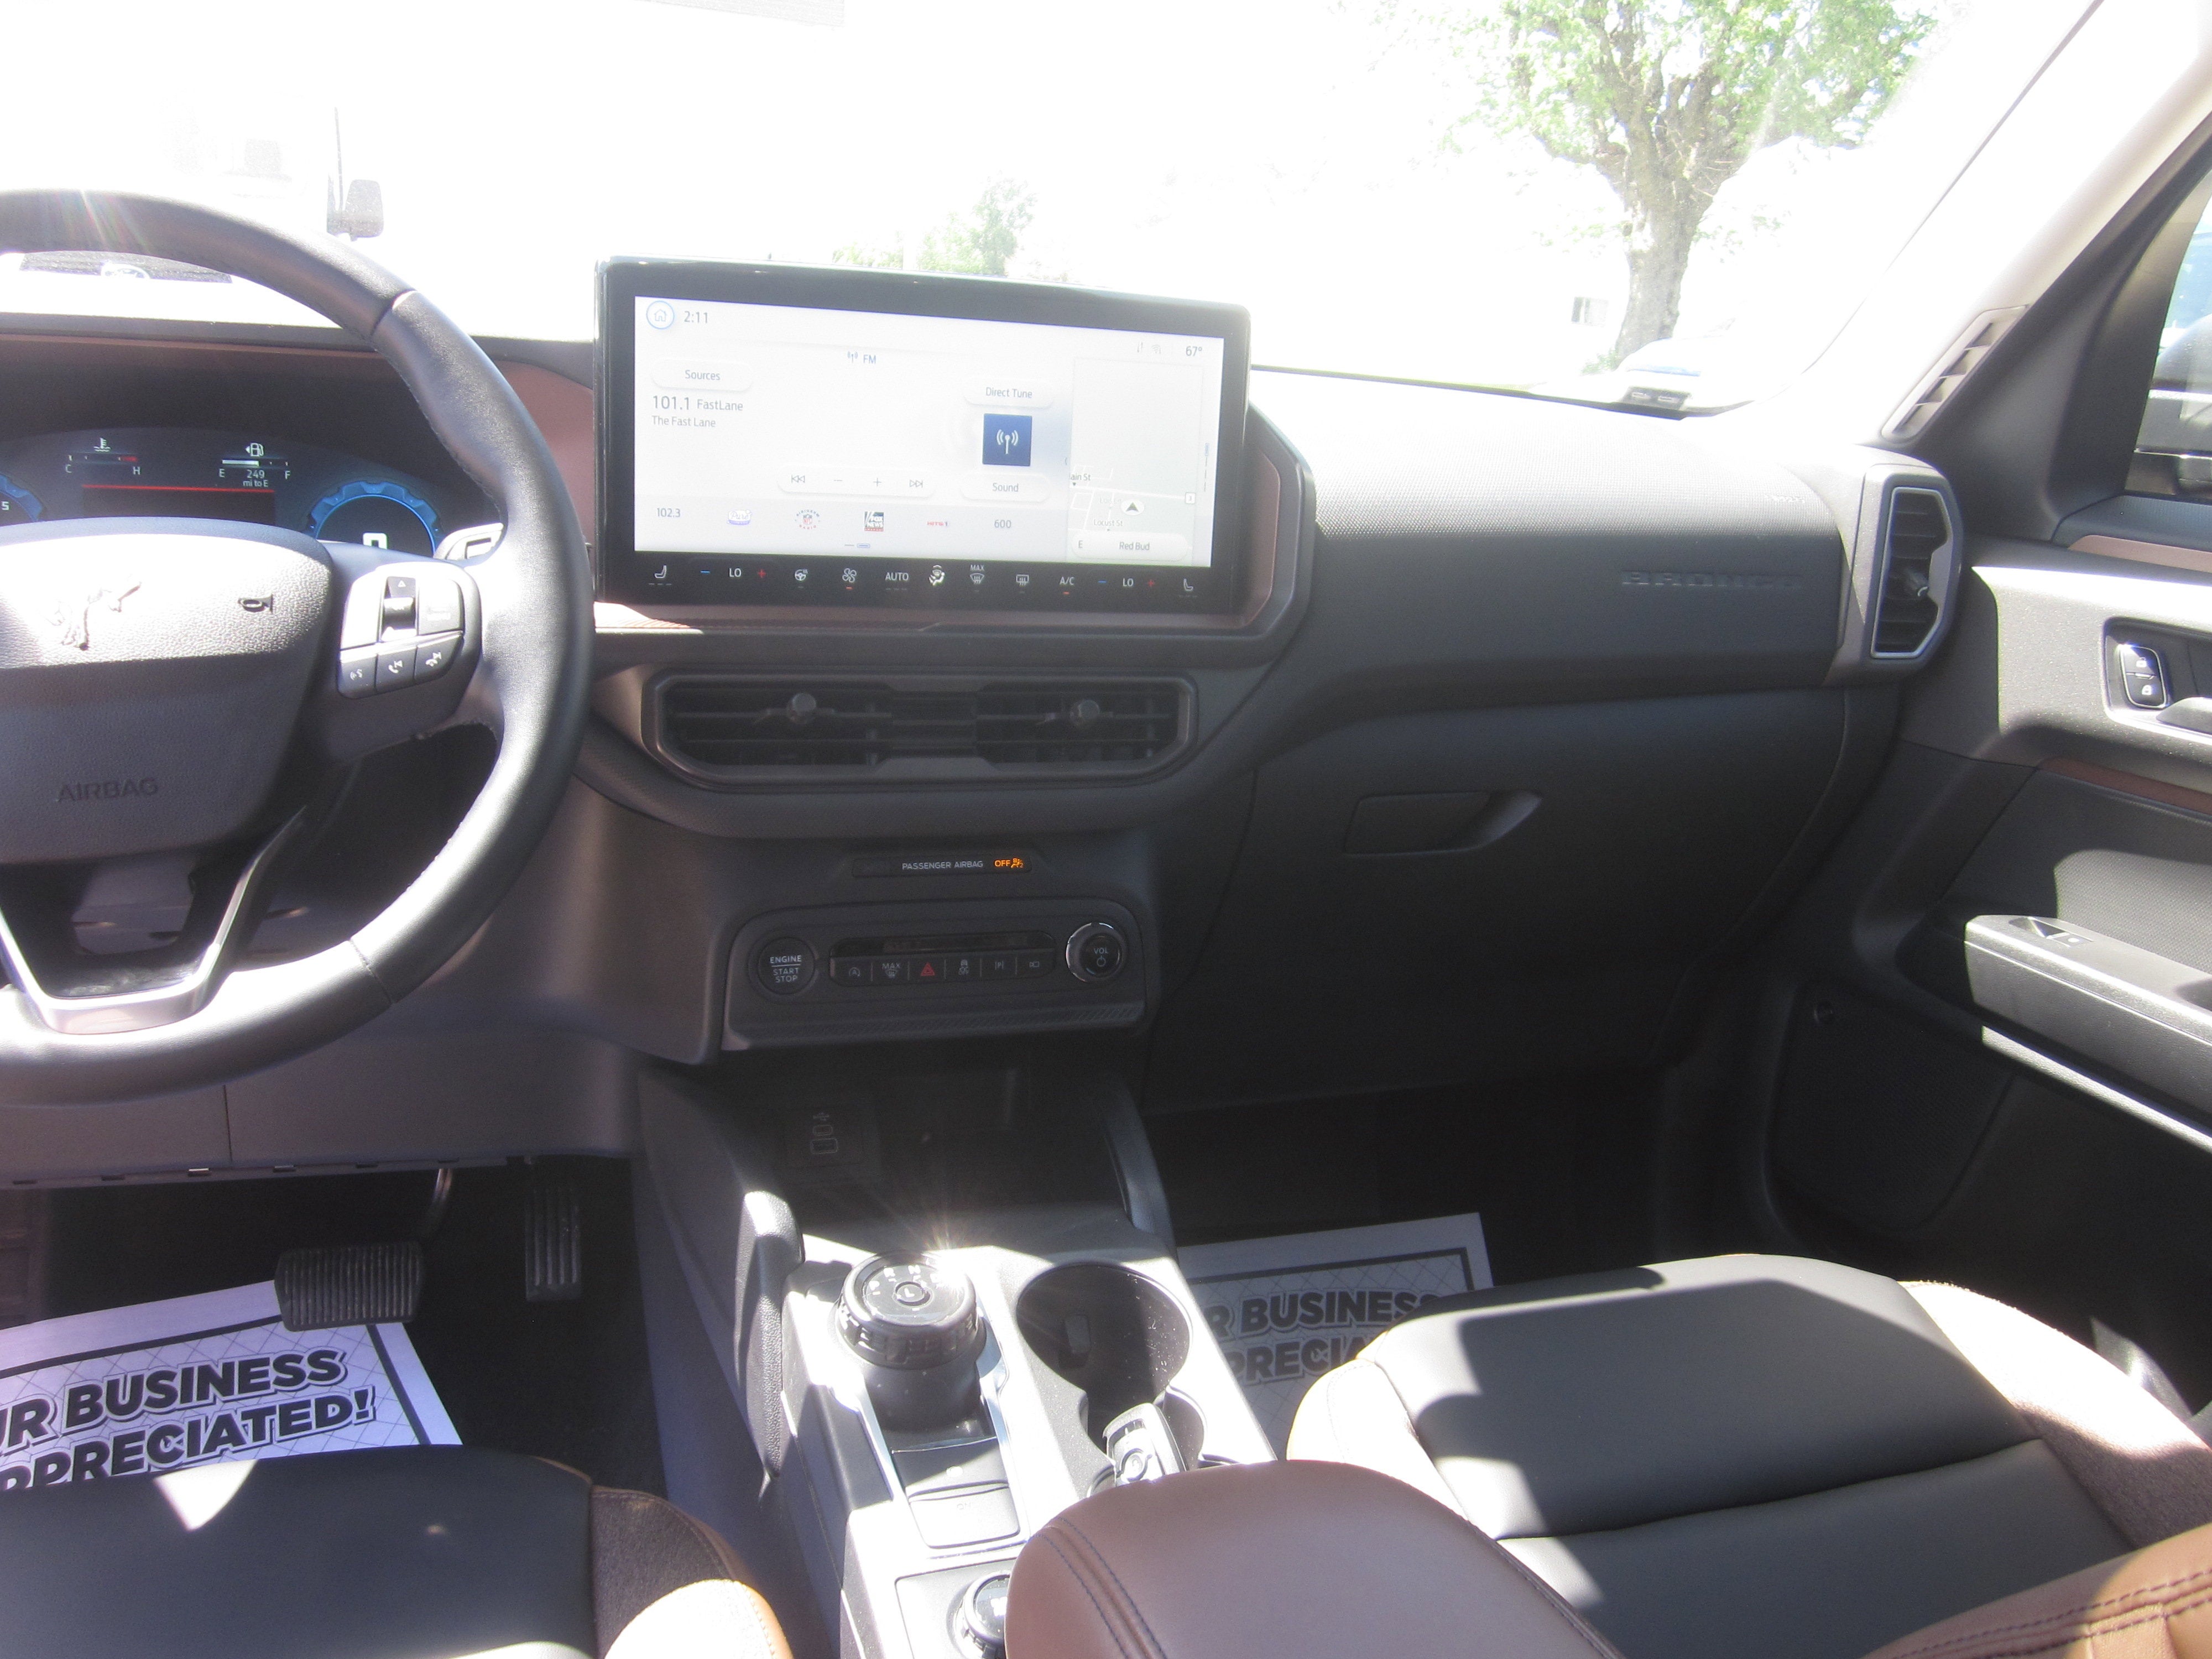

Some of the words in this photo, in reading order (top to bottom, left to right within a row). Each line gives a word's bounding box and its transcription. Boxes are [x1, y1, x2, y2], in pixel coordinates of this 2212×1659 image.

[684, 310, 708, 324] 2:11
[863, 354, 876, 364] FM
[685, 369, 721, 380] Sources
[985, 387, 1010, 397] Direct
[1013, 389, 1032, 398] Tune
[653, 395, 690, 410] 101.1
[651, 415, 669, 425] The
[671, 416, 691, 426] Fast
[693, 418, 716, 427] Lane
[65, 464, 72, 473] C
[133, 466, 140, 475] H
[218, 468, 226, 478] E
[247, 469, 265, 479] 249
[284, 470, 291, 479] F
[1083, 473, 1091, 481] St
[993, 482, 1019, 492] Sound
[656, 508, 681, 518] 102.3
[994, 519, 1011, 528] 600
[1078, 540, 1083, 549] E
[1119, 541, 1134, 550] Red
[1135, 542, 1150, 551] Bud
[729, 568, 742, 577] LO
[885, 572, 909, 581] AUTO
[1059, 576, 1074, 586] A/C
[1123, 578, 1134, 587] LO
[55, 778, 158, 802] AIRBAG
[902, 861, 951, 870] PASSENGER
[770, 955, 801, 964] ENGINE
[773, 967, 800, 976] START
[1240, 1290, 1439, 1334] BUSINES
[0, 1398, 50, 1447] R
[65, 1349, 346, 1429] BUSINESS
